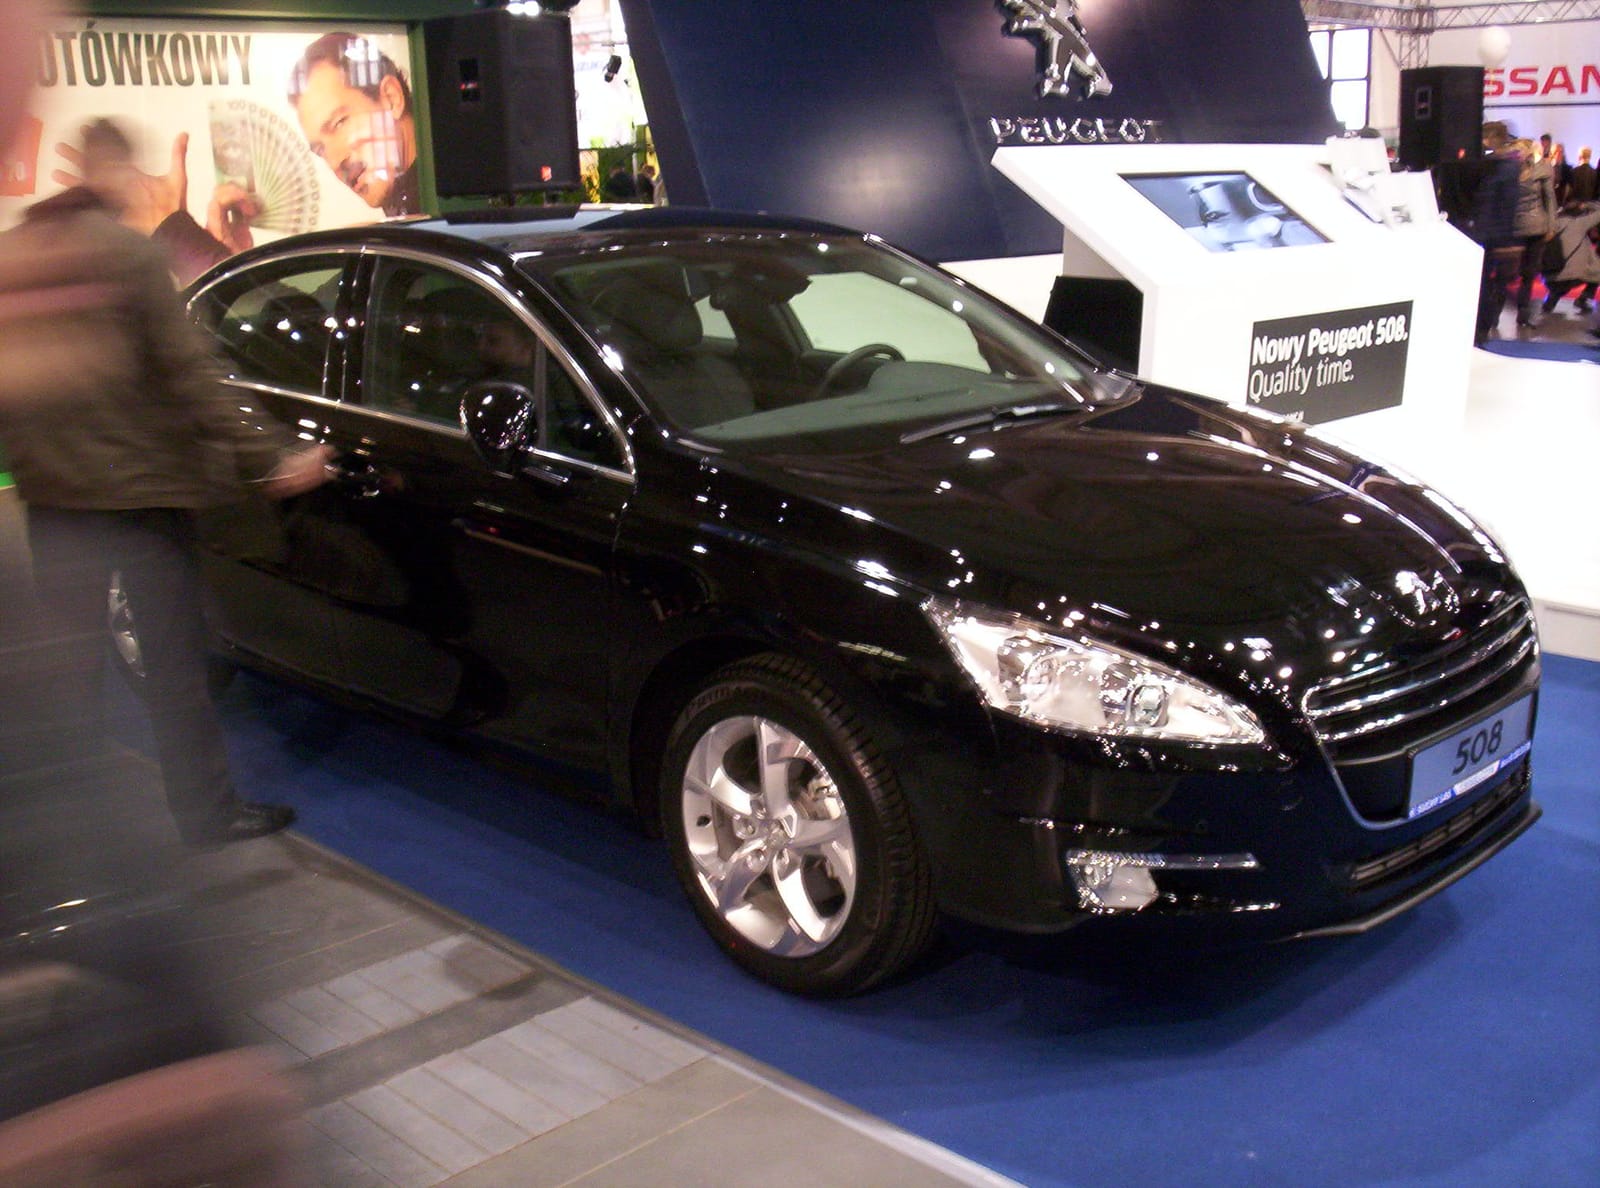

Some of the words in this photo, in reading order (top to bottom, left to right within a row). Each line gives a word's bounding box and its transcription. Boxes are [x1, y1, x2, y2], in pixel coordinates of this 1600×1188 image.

[989, 116, 1164, 144] PEUGEOT
[1252, 334, 1306, 366] Nowy
[1307, 319, 1374, 357] Peugeot
[1375, 314, 1408, 346] 508.
[1250, 363, 1313, 403] Quality
[1316, 357, 1355, 387] time.
[1451, 719, 1503, 775] 508
